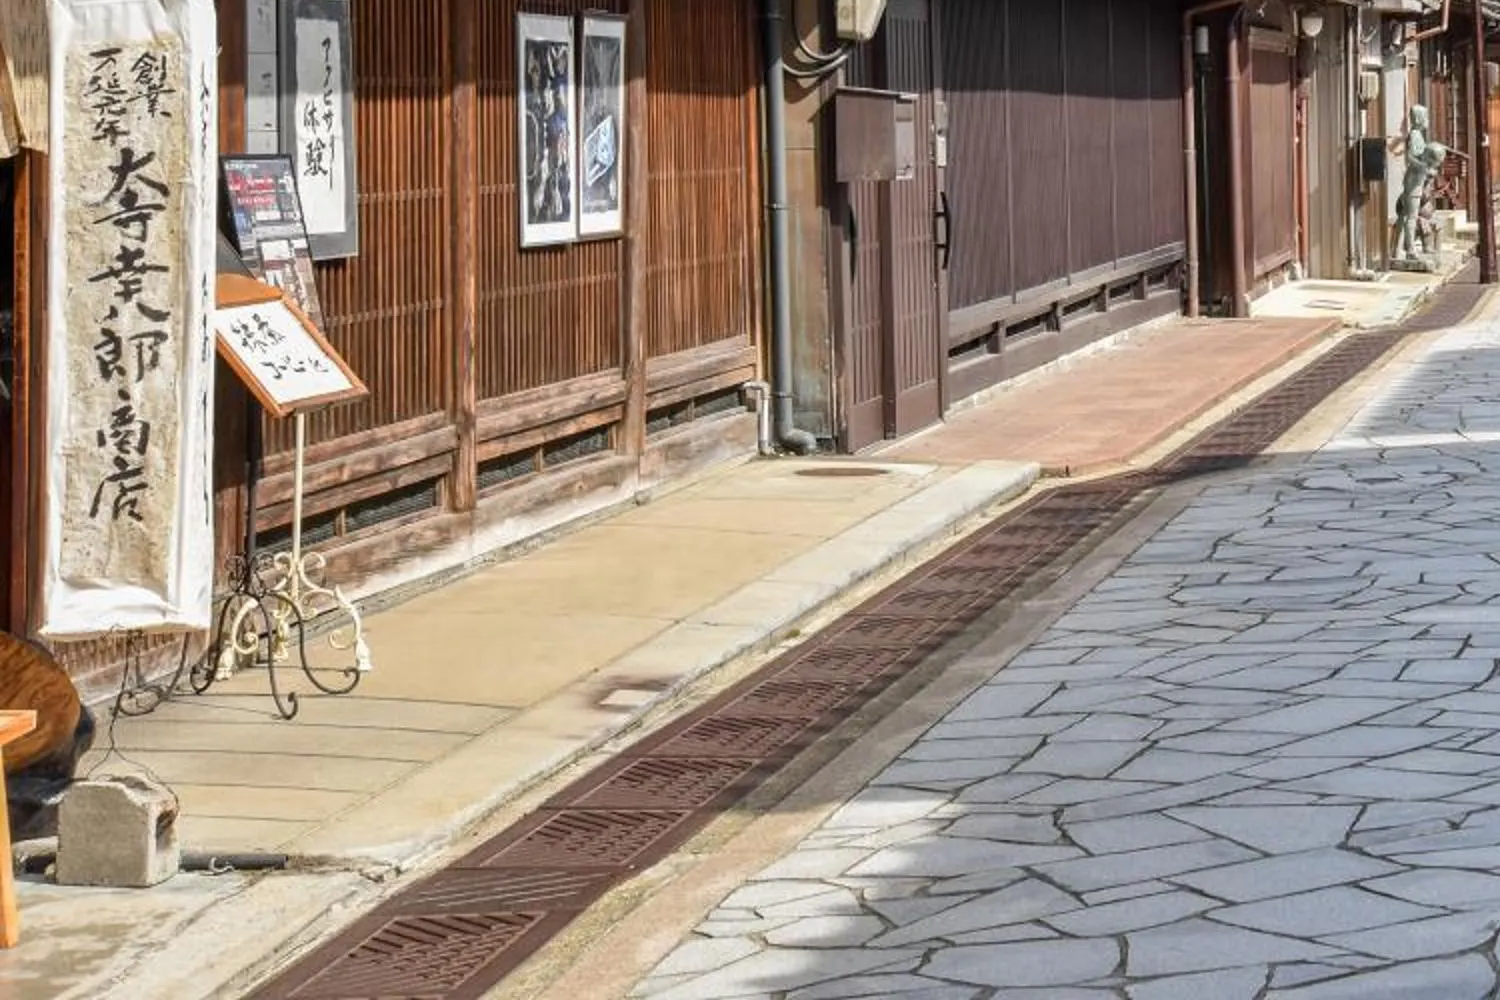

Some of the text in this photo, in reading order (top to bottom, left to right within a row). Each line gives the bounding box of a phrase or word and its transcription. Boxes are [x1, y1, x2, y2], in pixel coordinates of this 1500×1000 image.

[83, 47, 131, 148] 万延元年
[126, 51, 177, 118] 創業
[84, 146, 172, 522] 大寺幸八郎商店
